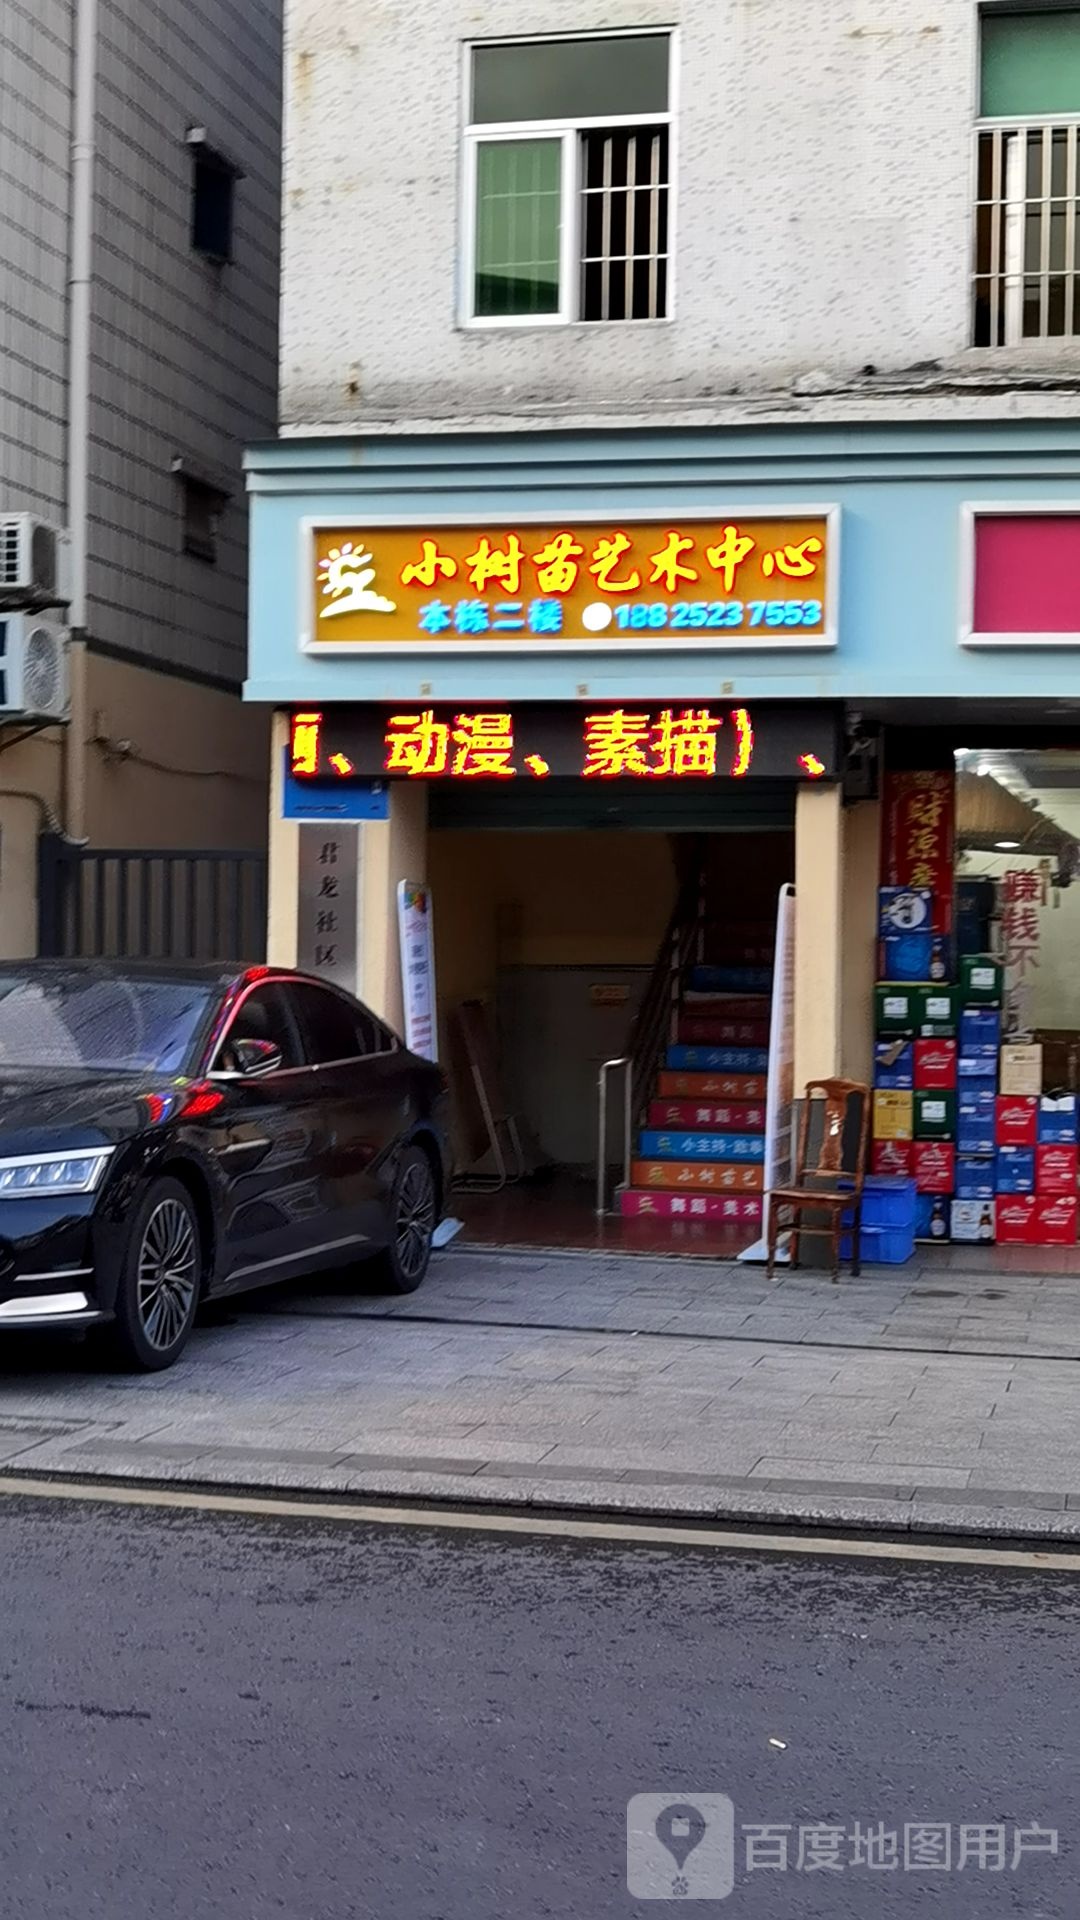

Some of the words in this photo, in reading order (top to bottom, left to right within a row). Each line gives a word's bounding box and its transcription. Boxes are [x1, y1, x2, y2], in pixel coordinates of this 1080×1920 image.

[401, 525, 823, 593] 小树苗艺术中心
[419, 599, 564, 633] 本栋二楼
